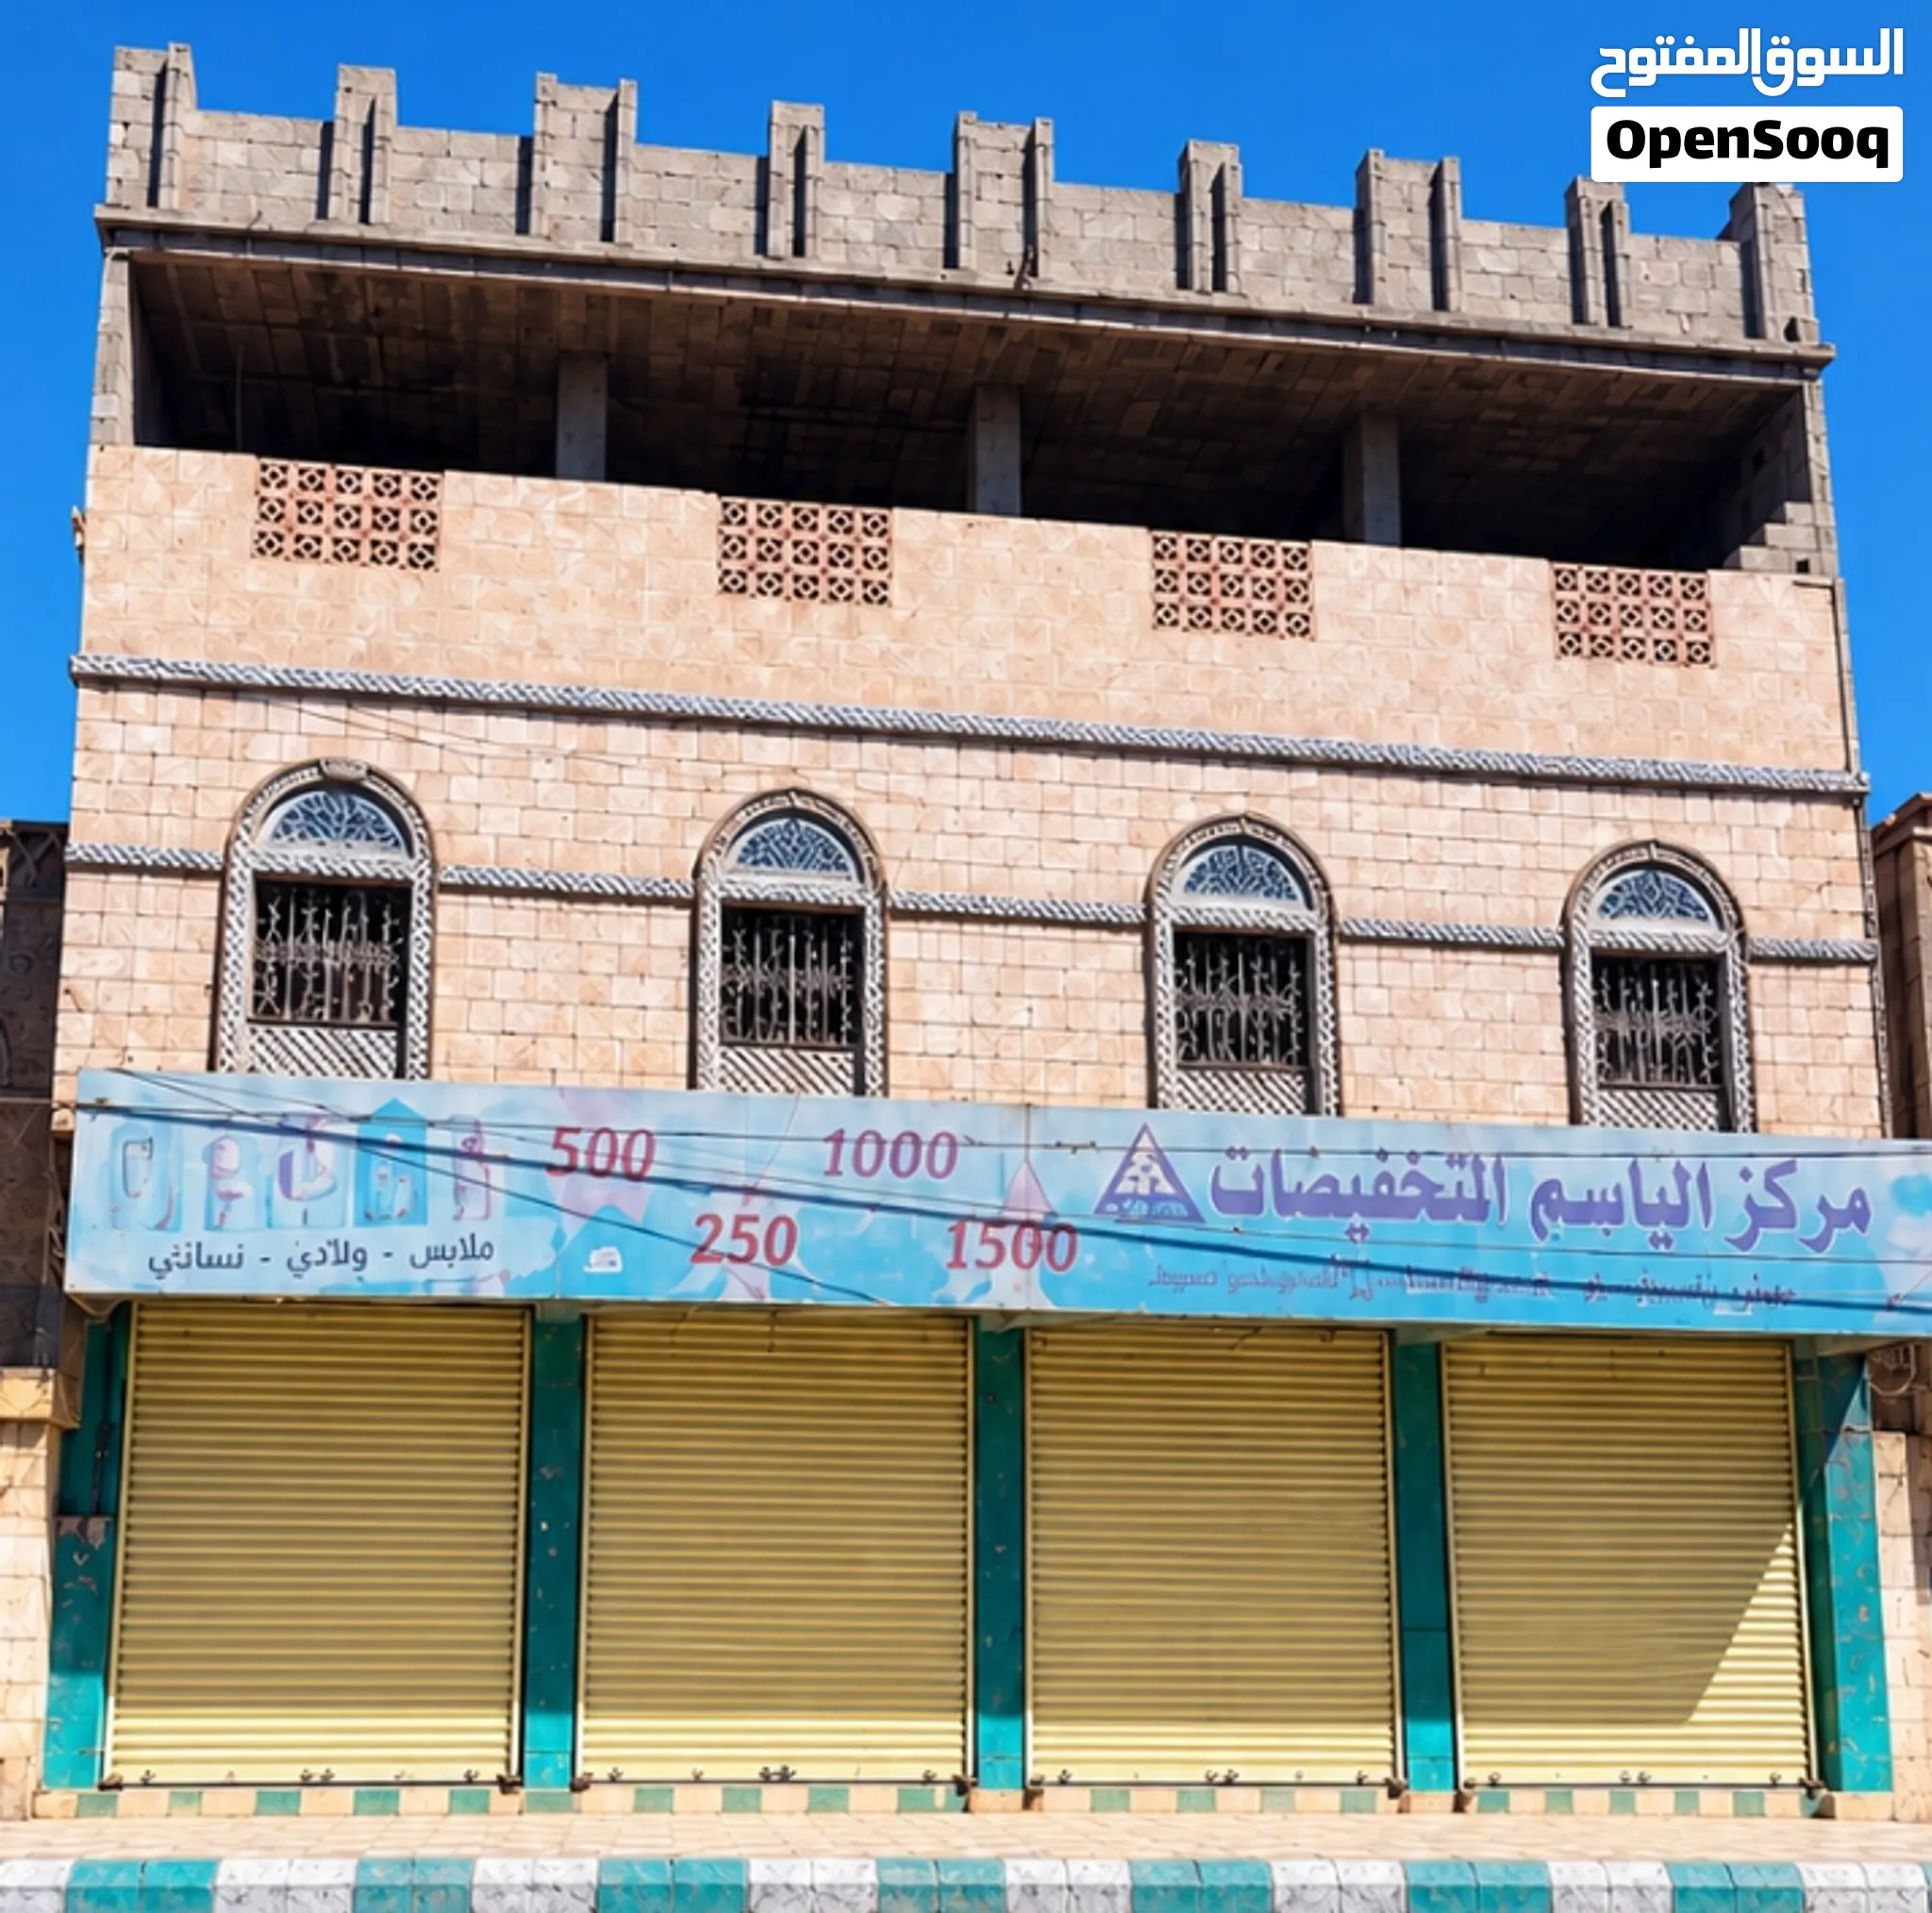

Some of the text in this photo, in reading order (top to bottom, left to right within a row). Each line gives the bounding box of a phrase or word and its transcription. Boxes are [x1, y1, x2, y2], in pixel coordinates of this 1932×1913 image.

[544, 1126, 656, 1182] 500
[823, 1129, 958, 1179] 1000
[1724, 1157, 1872, 1254] مركز
[408, 1232, 494, 1270] ملابس
[691, 1213, 798, 1266] 250
[946, 1221, 1078, 1273] 1500
